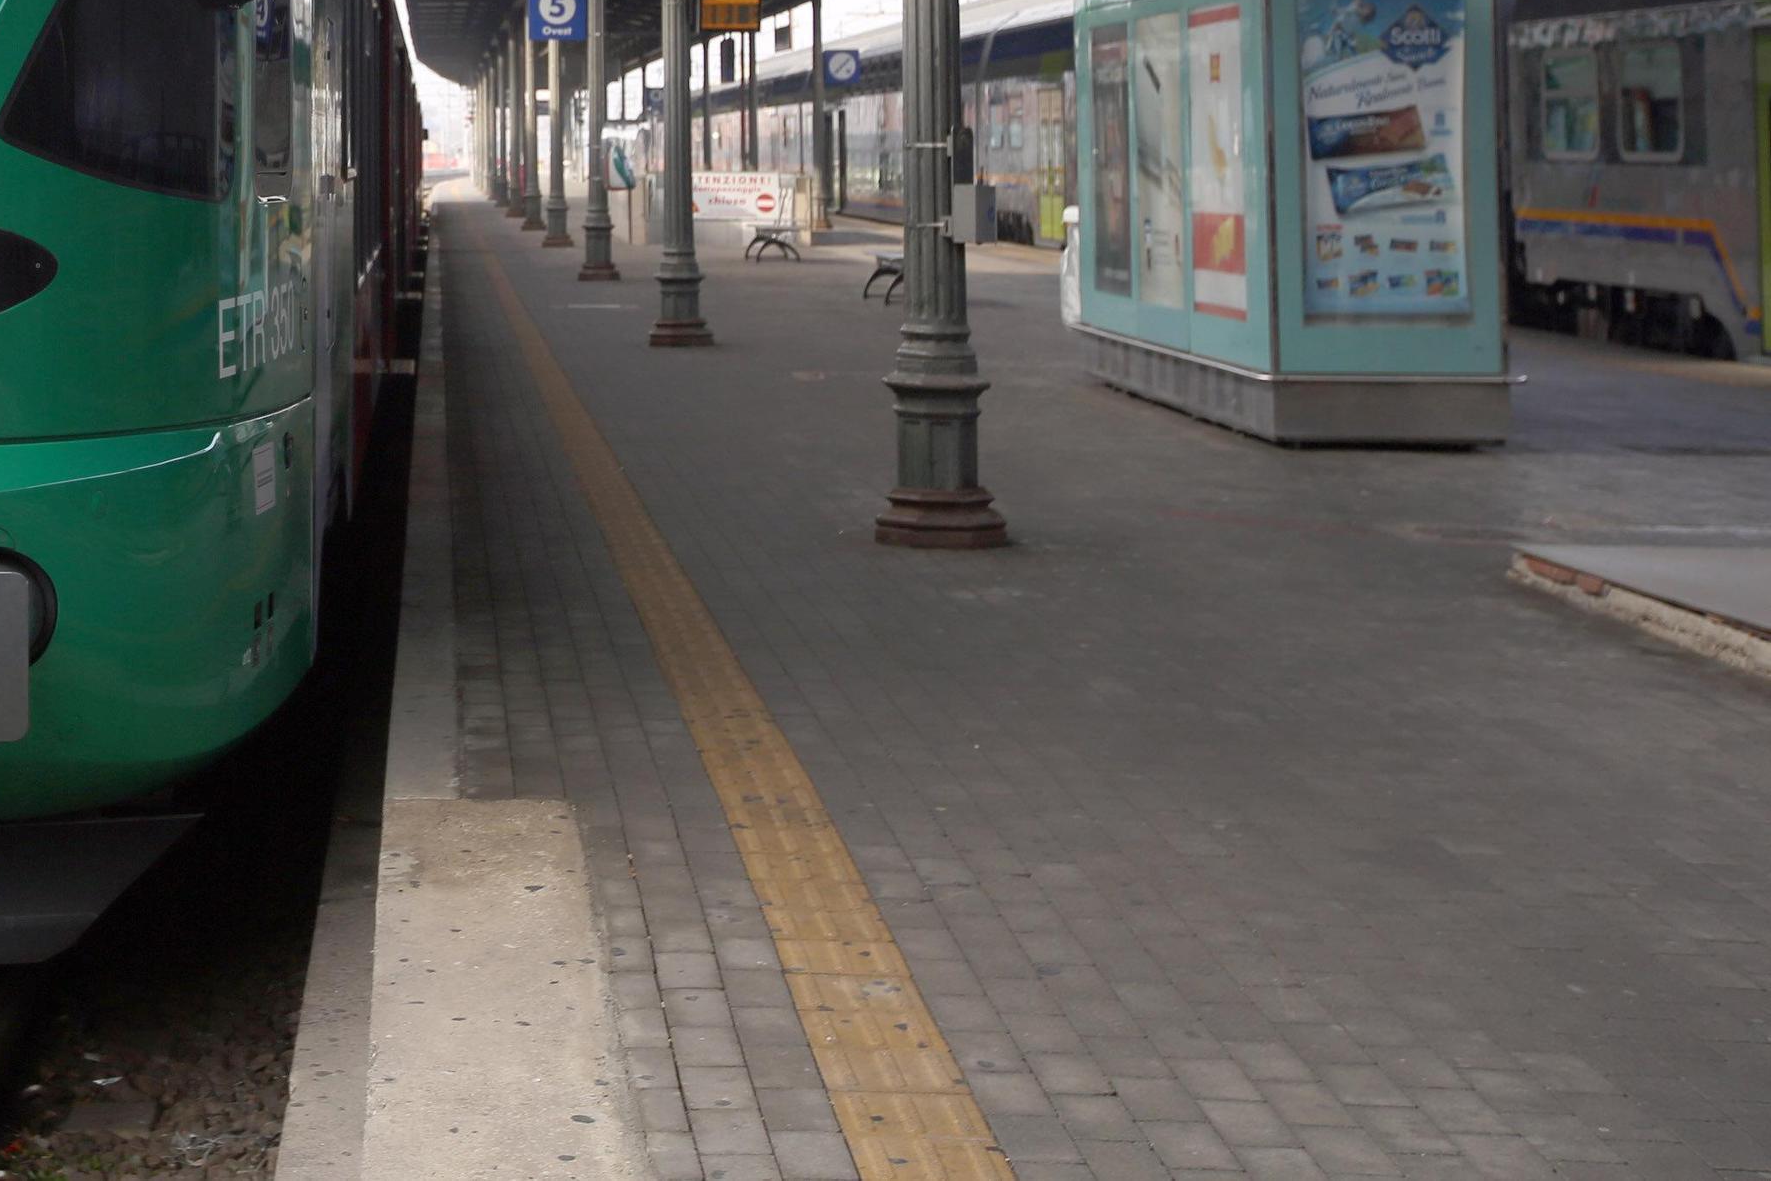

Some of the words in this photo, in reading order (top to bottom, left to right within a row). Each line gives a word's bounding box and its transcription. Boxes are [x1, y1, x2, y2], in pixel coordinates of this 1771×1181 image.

[541, 26, 573, 36] Ovest
[697, 175, 772, 185] TENZIONE!
[218, 291, 267, 380] ETR
[270, 282, 296, 361] 350
